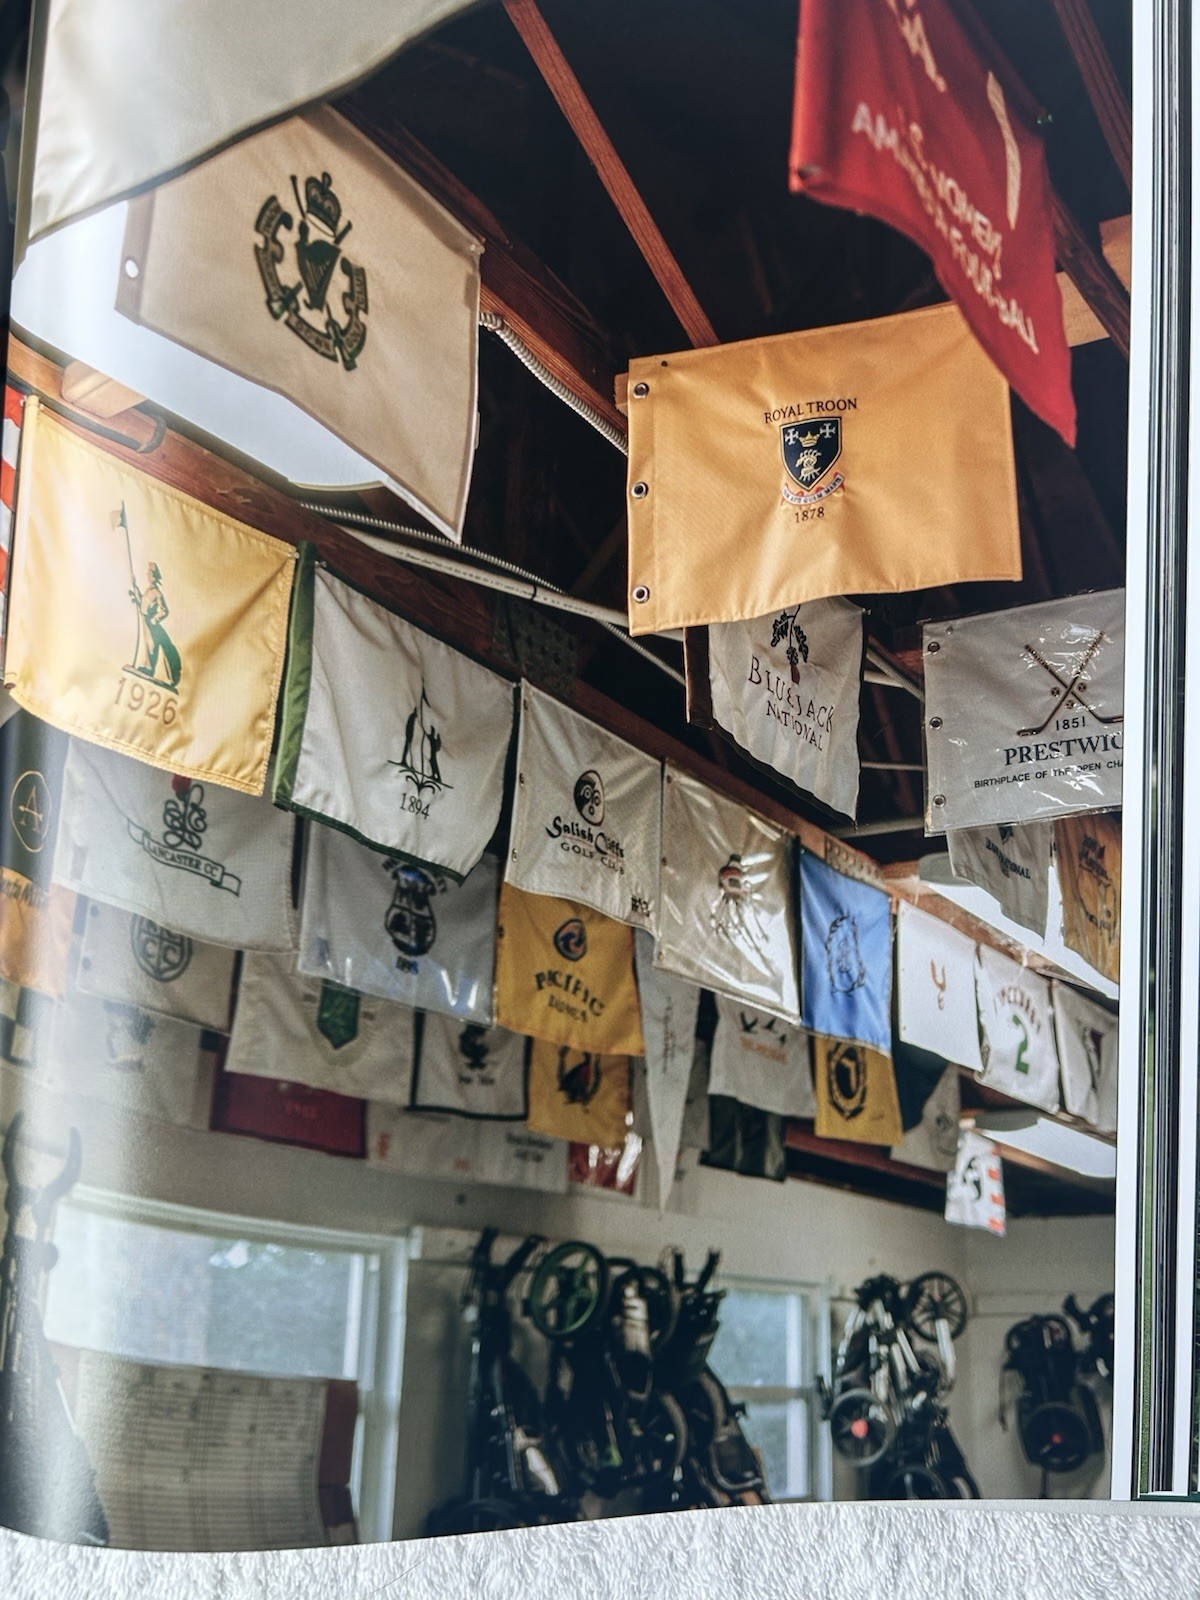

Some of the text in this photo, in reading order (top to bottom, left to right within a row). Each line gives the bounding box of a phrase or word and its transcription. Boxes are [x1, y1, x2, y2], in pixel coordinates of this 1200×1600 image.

[764, 398, 858, 424] ROYAL TROON
[795, 506, 825, 523] 1878
[114, 677, 178, 726] 1926
[749, 656, 835, 733] BLUEJACK
[766, 700, 823, 751] NATIONAL
[1056, 716, 1086, 731] 1851
[1004, 732, 1123, 766] PRESTWIC
[974, 773, 1031, 789] BIRTHPLACE
[1035, 770, 1048, 780] OF
[1077, 762, 1102, 773] OPEN
[399, 793, 431, 820] 1894
[545, 815, 625, 858] Salish Cliffs
[147, 841, 219, 878] LANCASTER CC
[561, 842, 625, 875] GOLF CLUB
[535, 969, 605, 1017] PACIFIC
